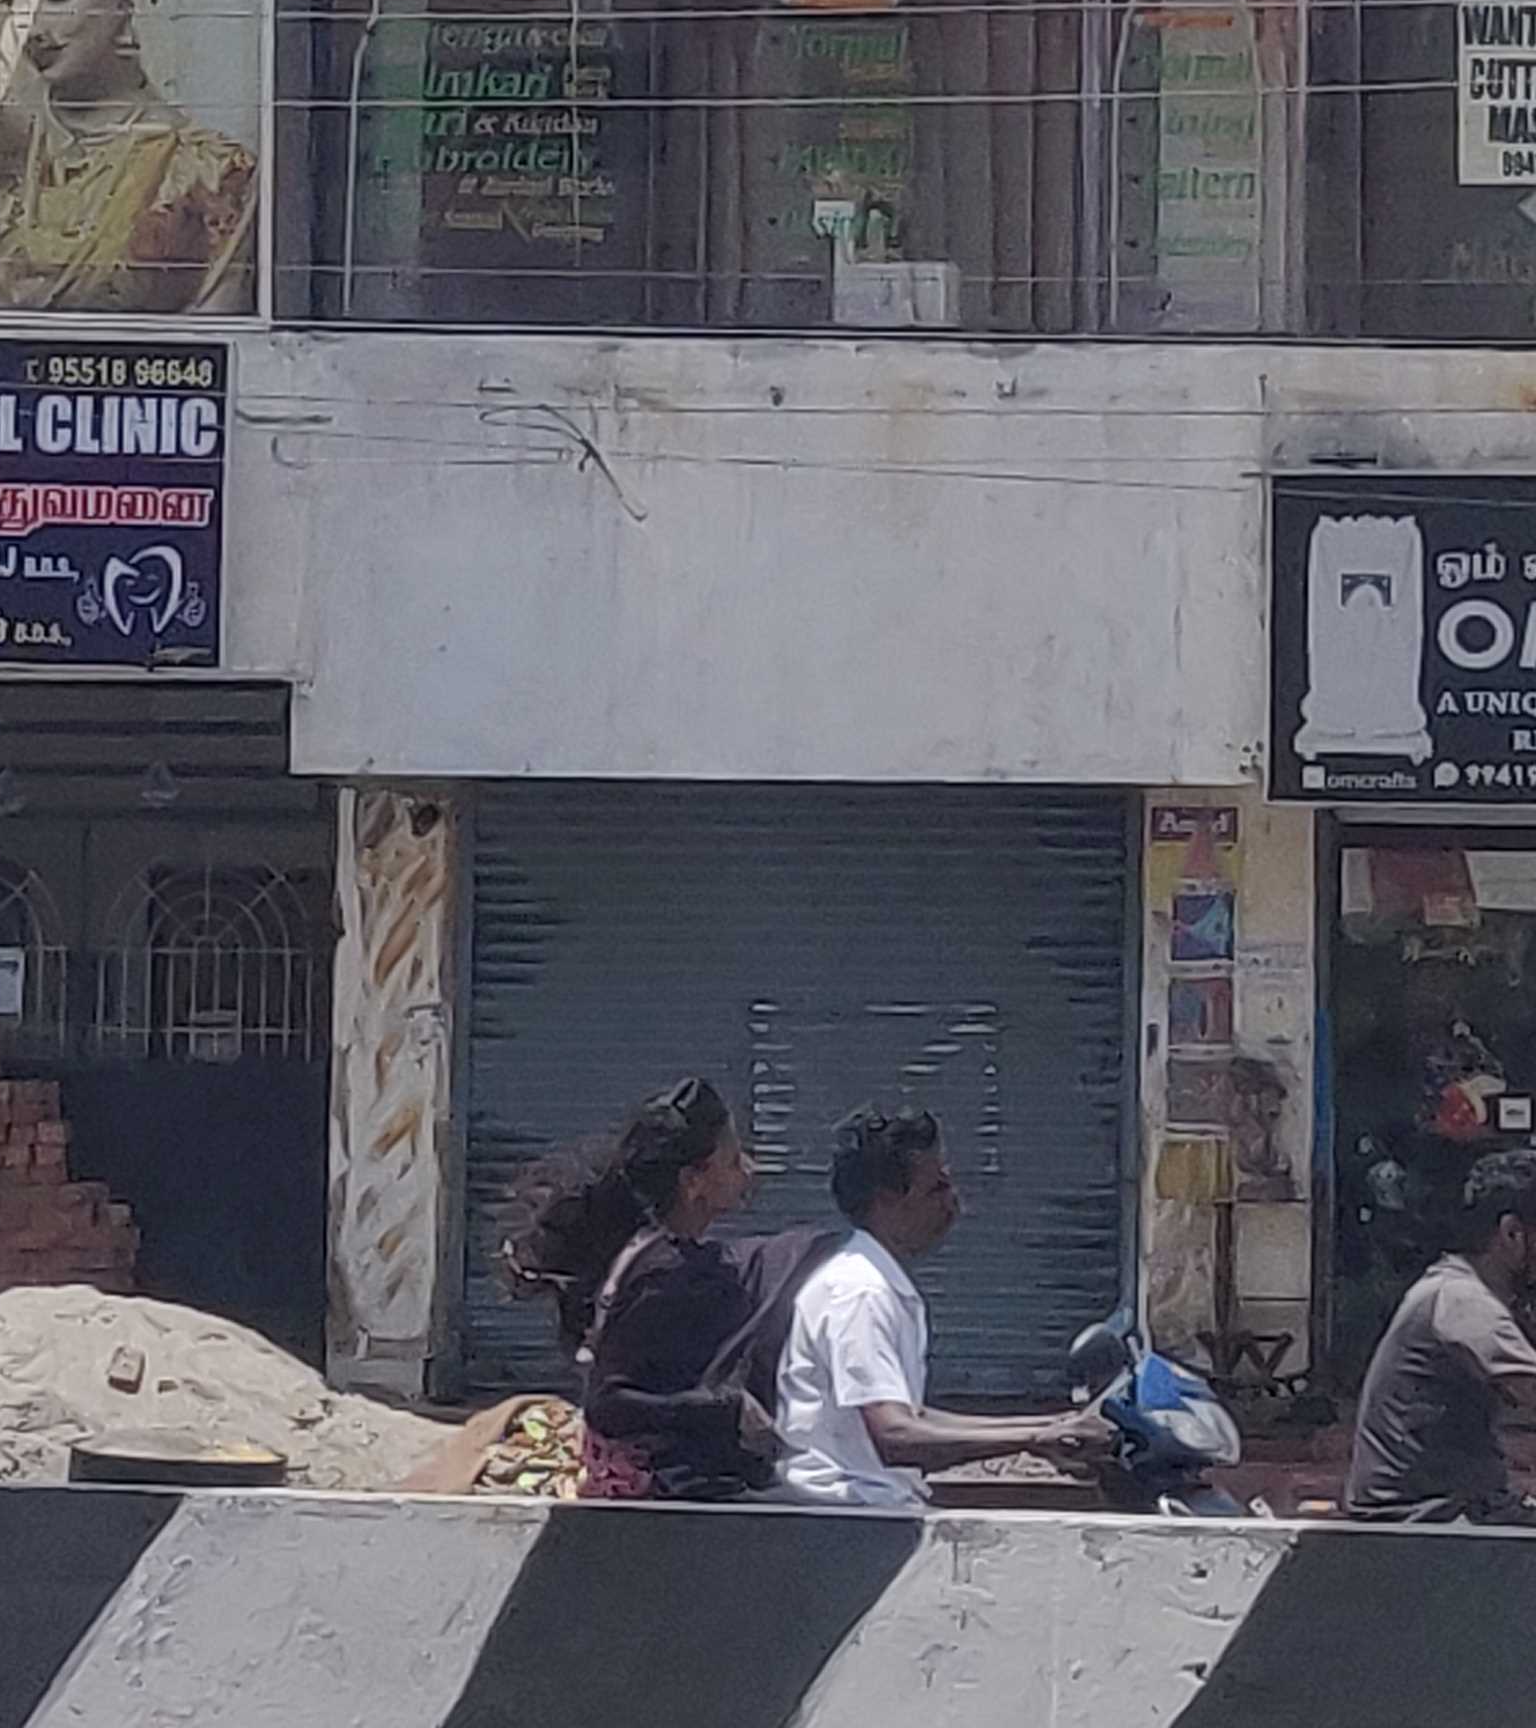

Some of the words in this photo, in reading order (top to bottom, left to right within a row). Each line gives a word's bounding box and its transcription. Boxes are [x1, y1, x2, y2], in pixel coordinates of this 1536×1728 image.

[48, 356, 127, 385] 95518
[34, 393, 220, 456] CLINIC
[1436, 691, 1460, 715] A
